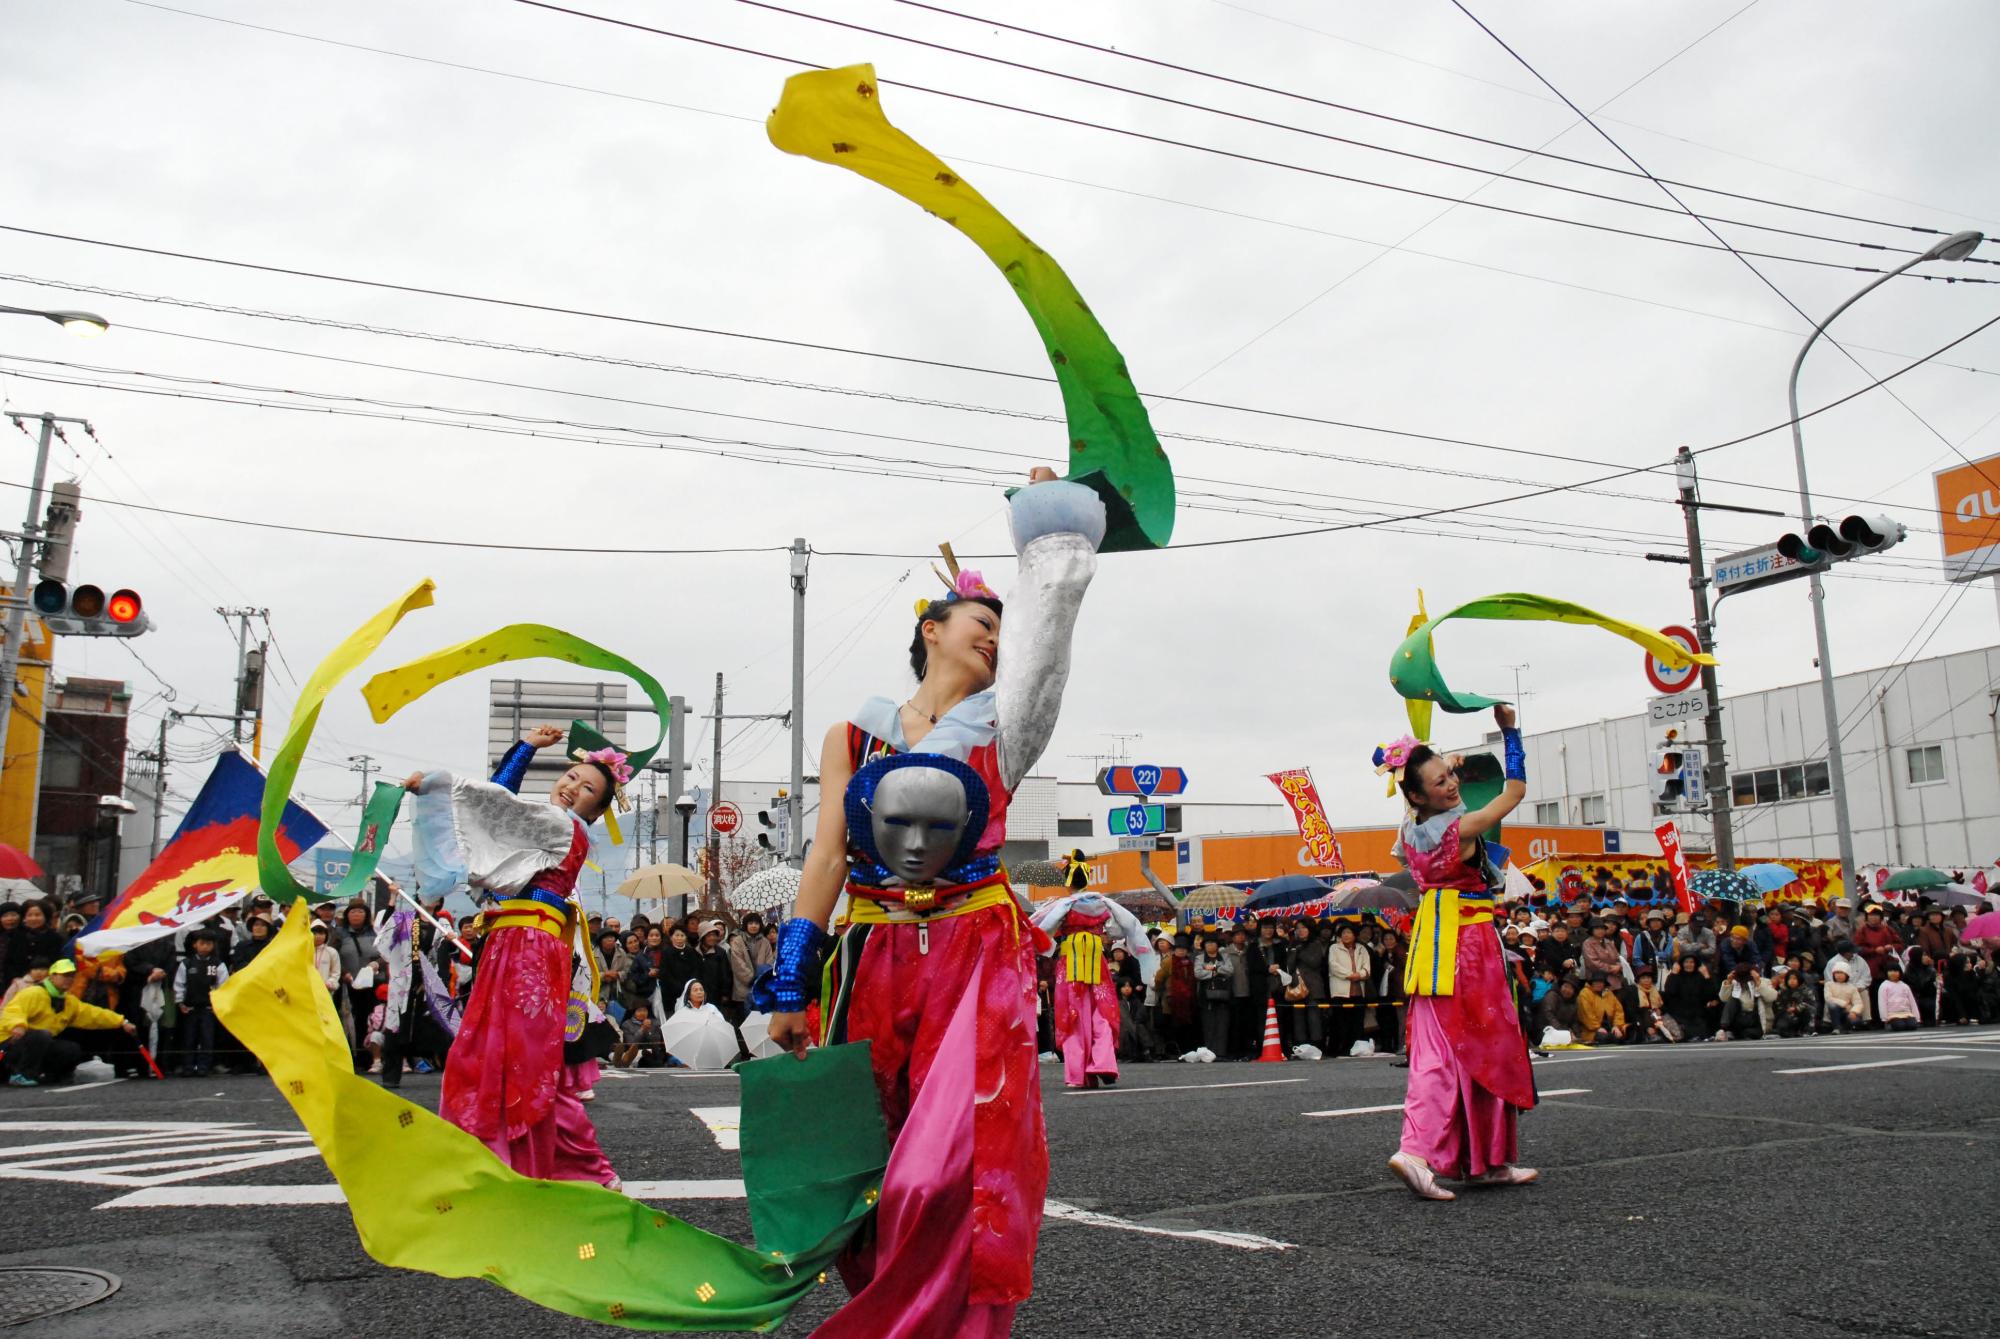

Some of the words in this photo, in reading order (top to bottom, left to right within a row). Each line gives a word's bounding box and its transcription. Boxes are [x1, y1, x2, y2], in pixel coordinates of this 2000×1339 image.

[1956, 489, 2000, 523] au
[1653, 697, 1703, 719] ここから
[1137, 770, 1157, 785] 221
[713, 814, 736, 825] 消火栓
[1129, 811, 1143, 829] 53
[1281, 774, 1336, 864] から揚げ
[1528, 838, 1558, 859] au
[1088, 864, 1108, 886] au
